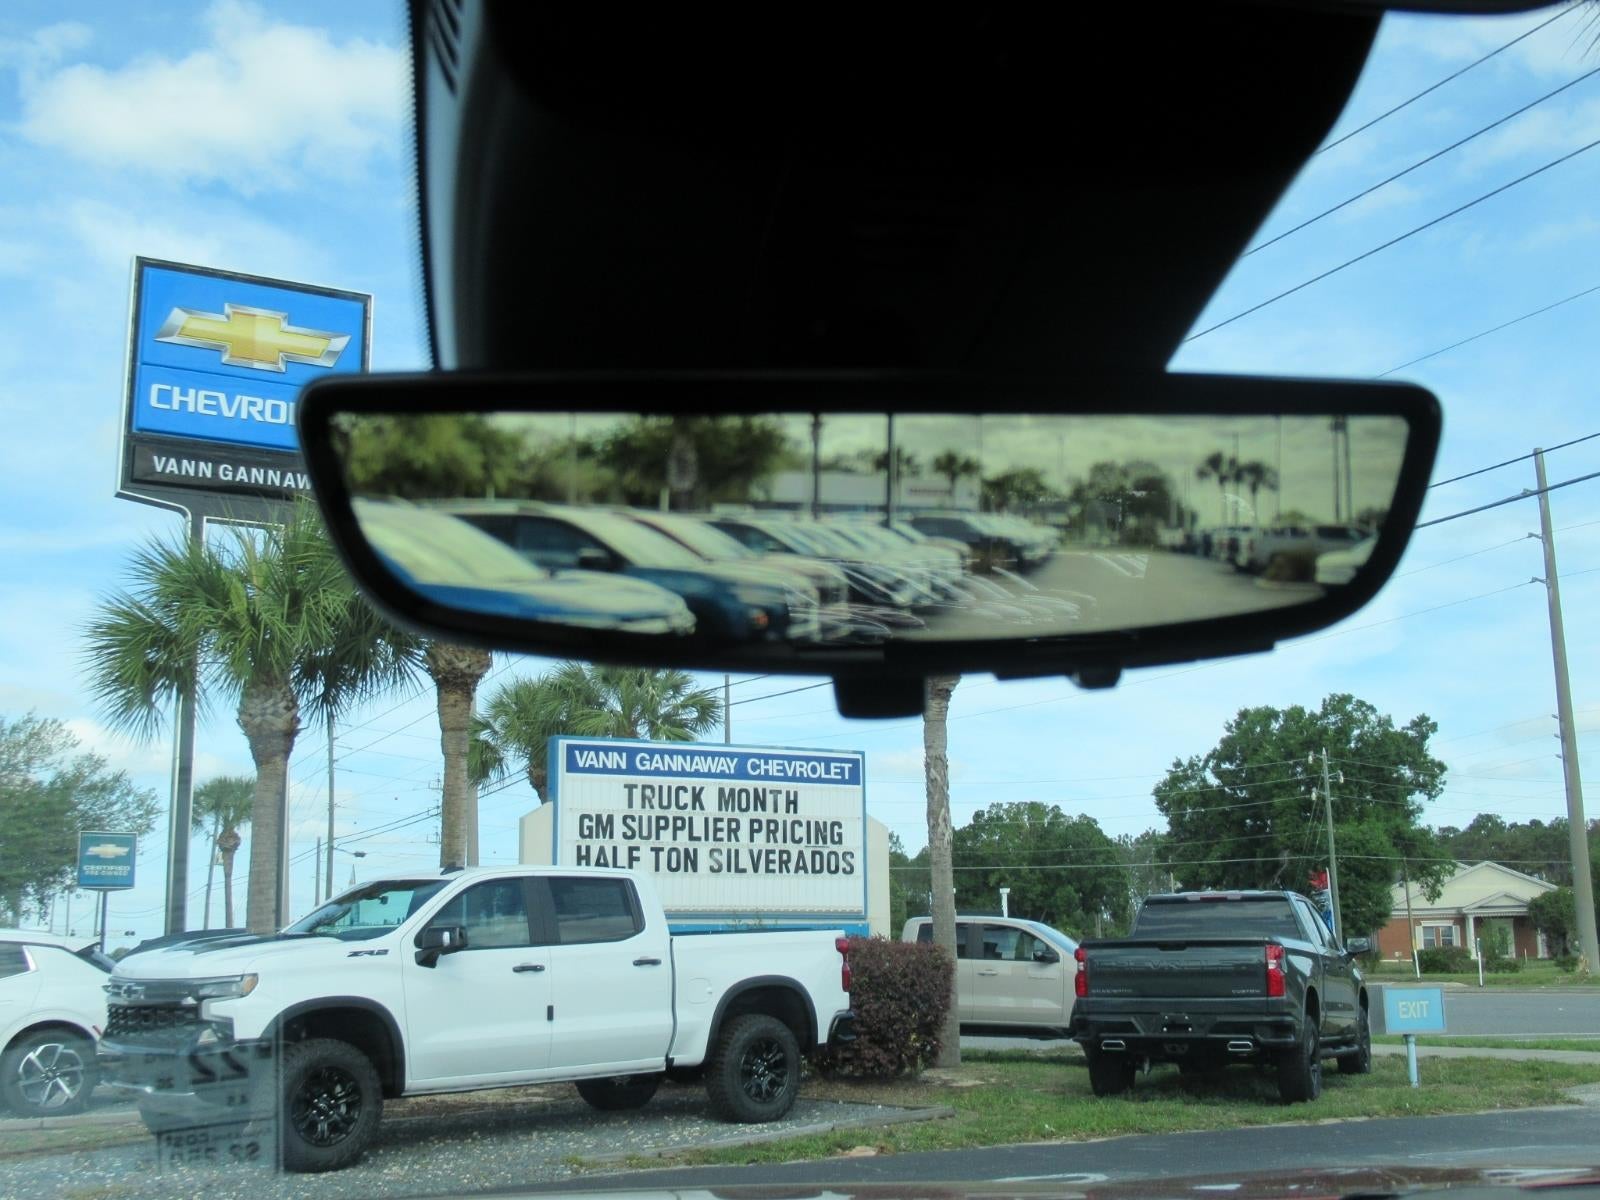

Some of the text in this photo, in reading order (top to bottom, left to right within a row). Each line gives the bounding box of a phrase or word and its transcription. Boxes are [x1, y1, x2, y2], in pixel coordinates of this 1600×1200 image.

[153, 455, 213, 479] VANN
[574, 750, 853, 780] VANN GANNAWAY CHEVROLET
[623, 783, 799, 814] TRUCK MONTH
[578, 813, 843, 846] GM SUPPLIER PRICING
[576, 844, 855, 875] HALF TON SILVERADOS
[1398, 1000, 1429, 1019] EXIT
